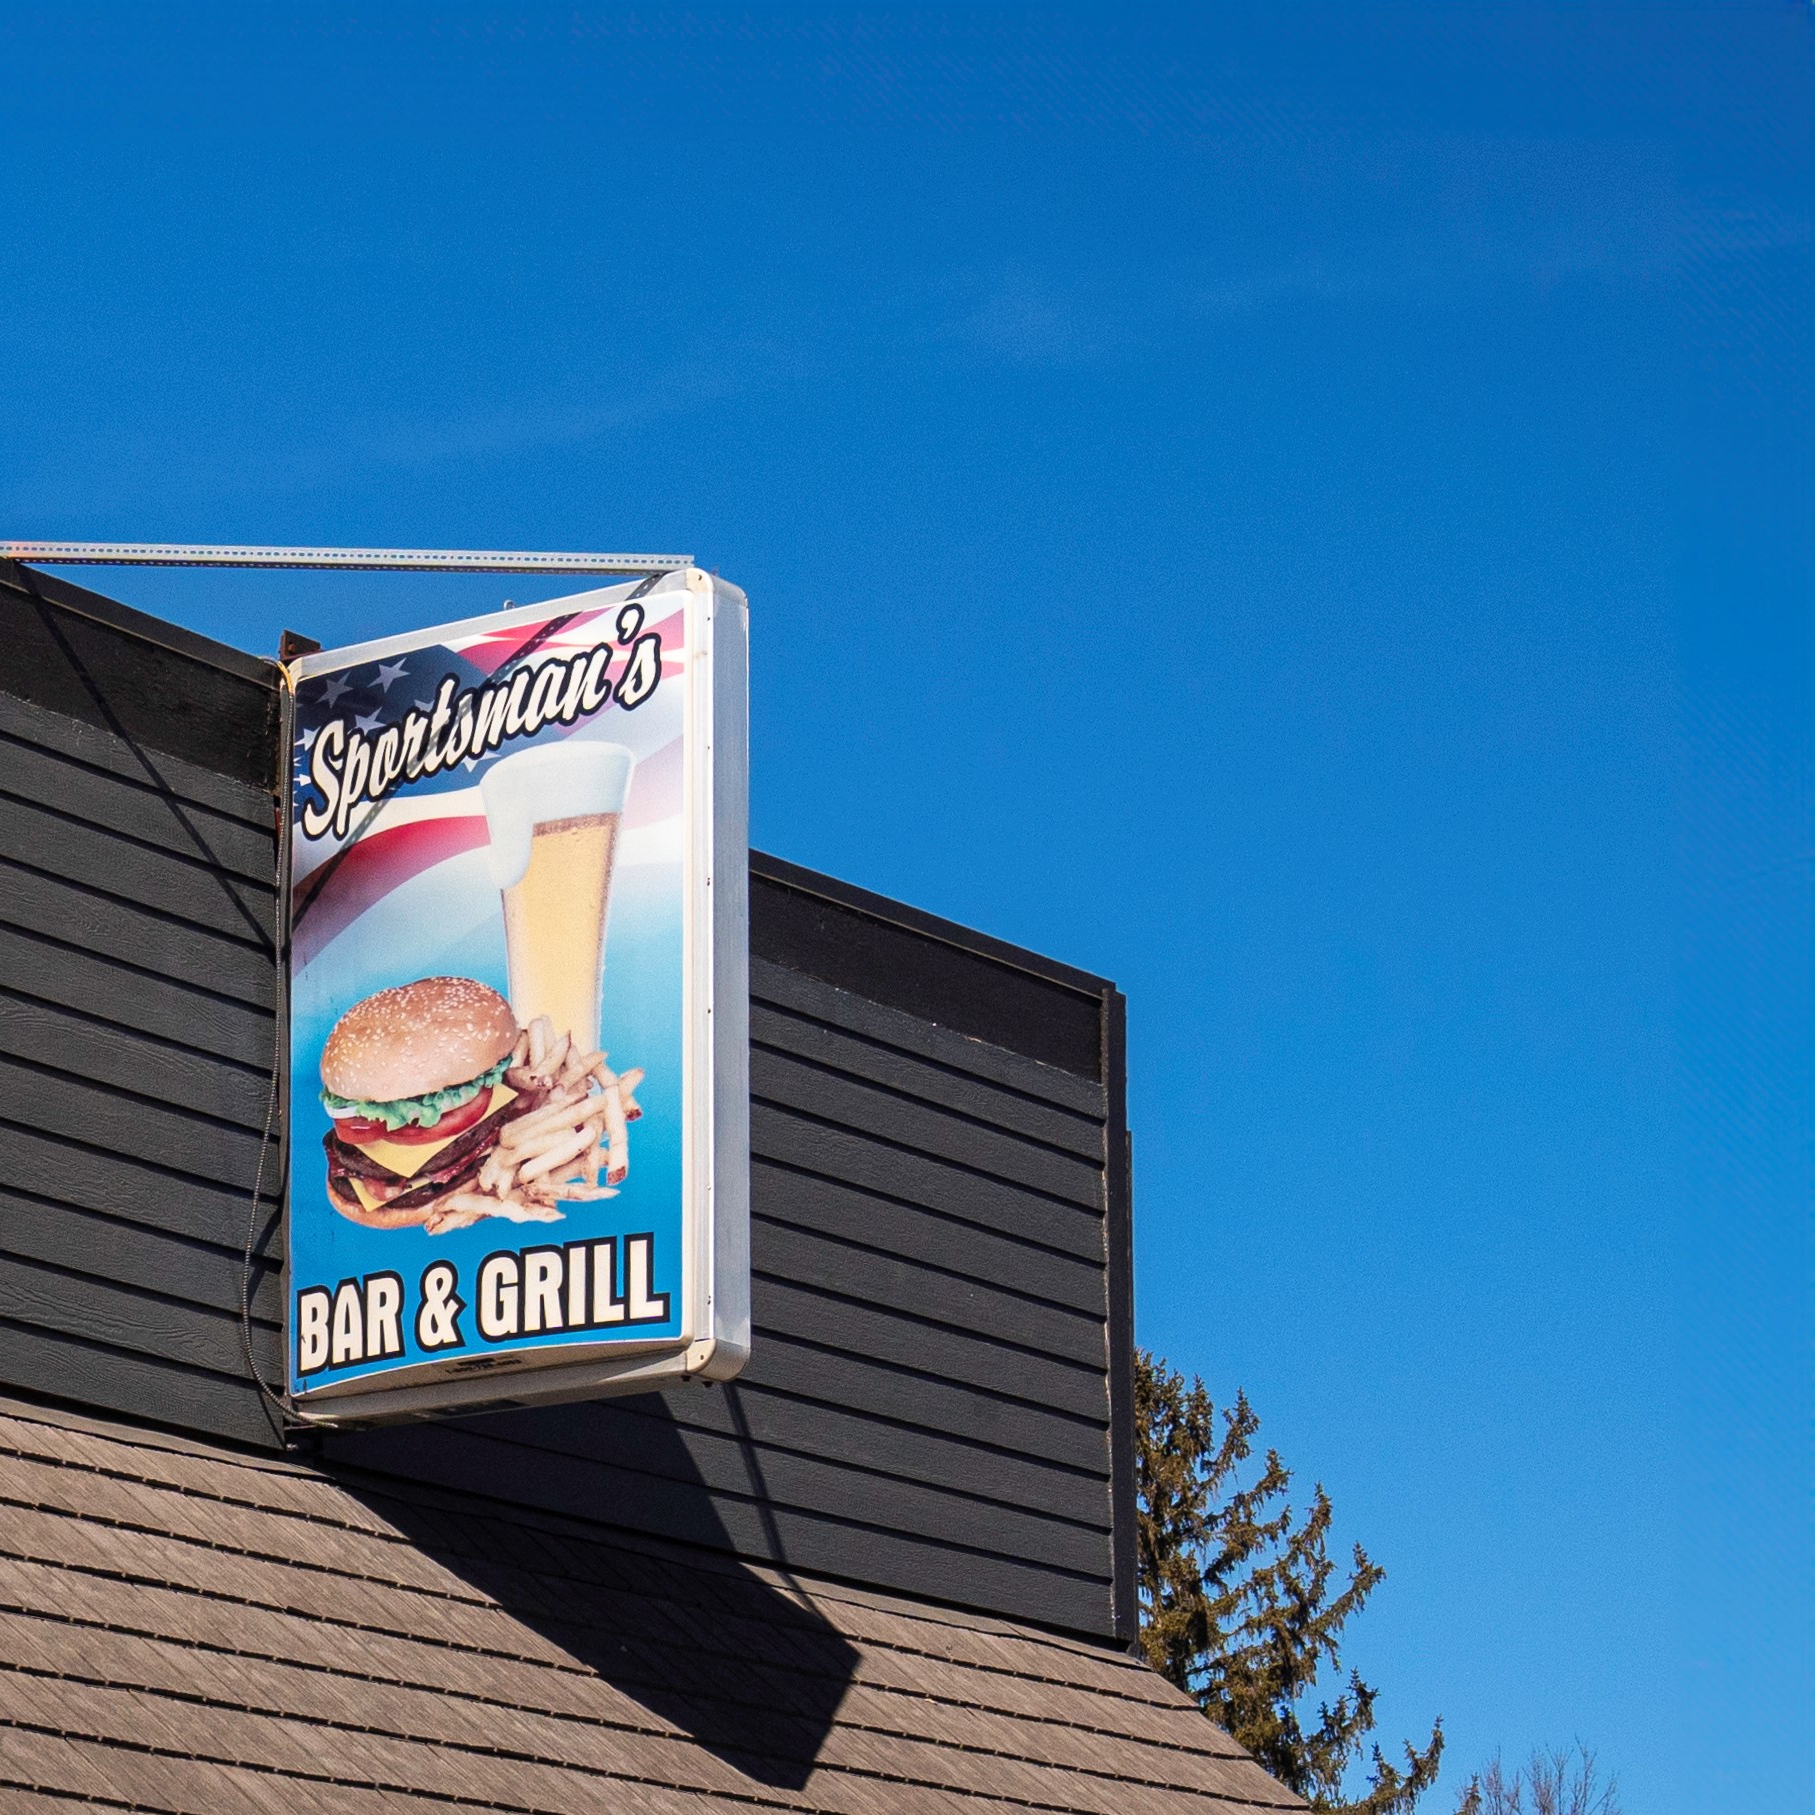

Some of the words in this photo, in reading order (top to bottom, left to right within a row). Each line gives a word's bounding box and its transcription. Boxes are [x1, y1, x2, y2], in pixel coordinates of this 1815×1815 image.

[302, 604, 661, 840] Sportsman's
[297, 1270, 405, 1378] BAR
[415, 1260, 467, 1353] &
[476, 1232, 671, 1342] GRILL
